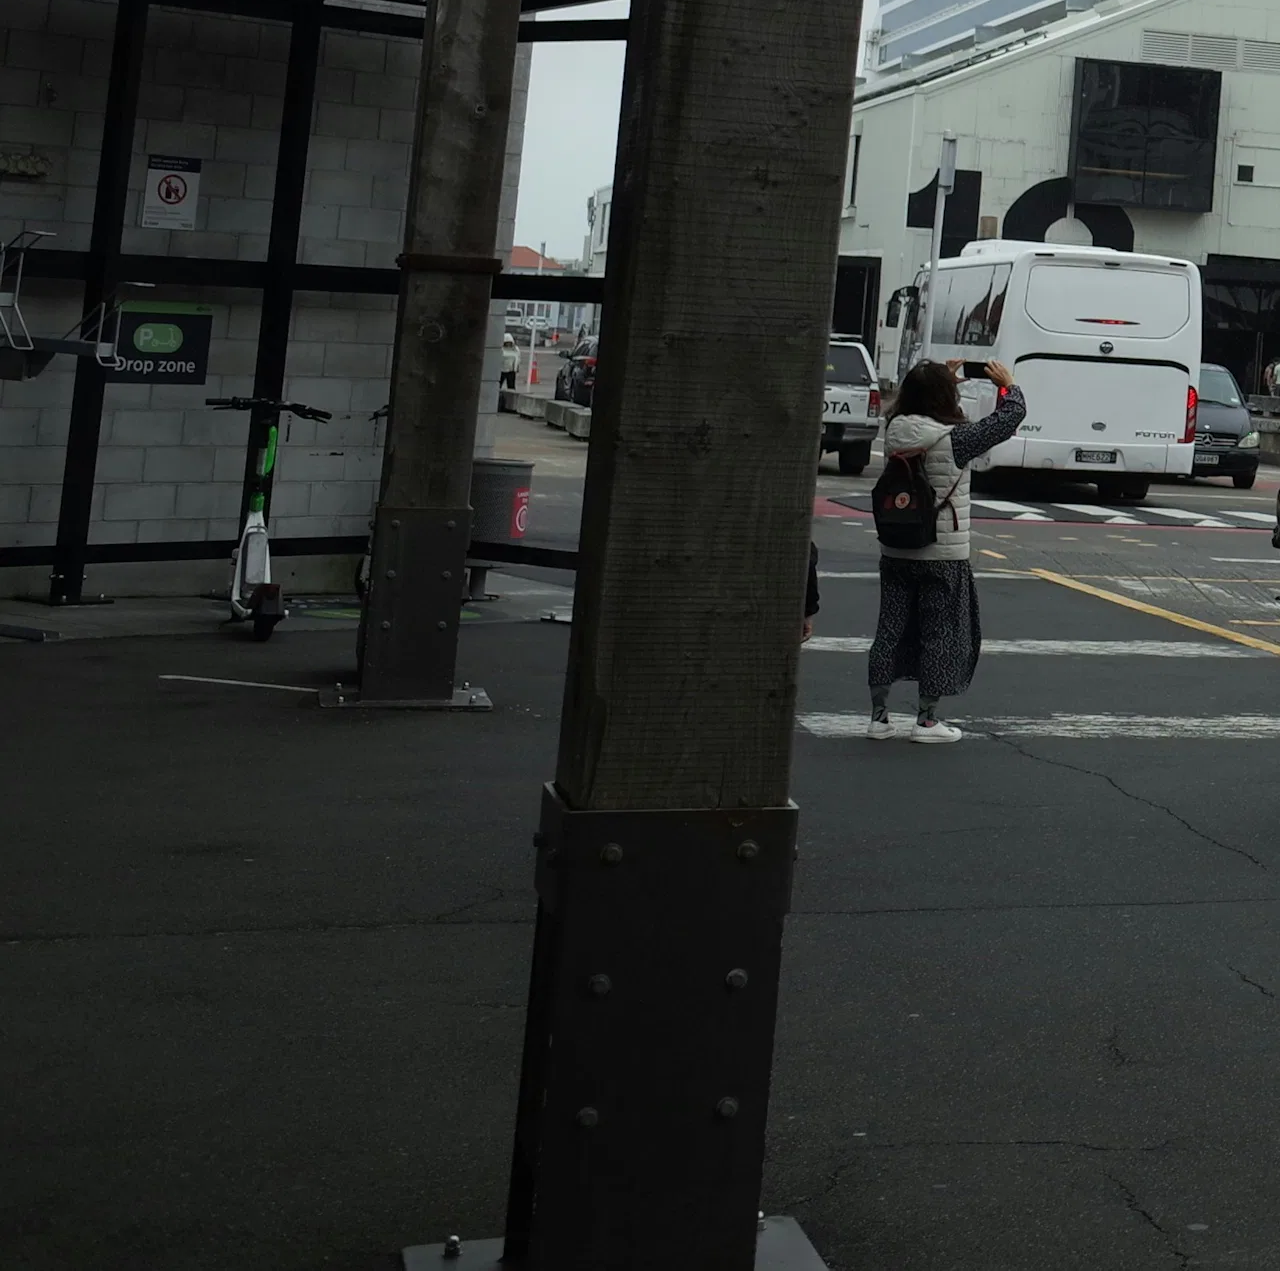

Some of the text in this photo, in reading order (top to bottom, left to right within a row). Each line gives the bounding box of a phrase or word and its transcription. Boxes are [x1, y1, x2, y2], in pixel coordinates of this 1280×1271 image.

[139, 328, 153, 346] P
[114, 356, 196, 374] Drop zone
